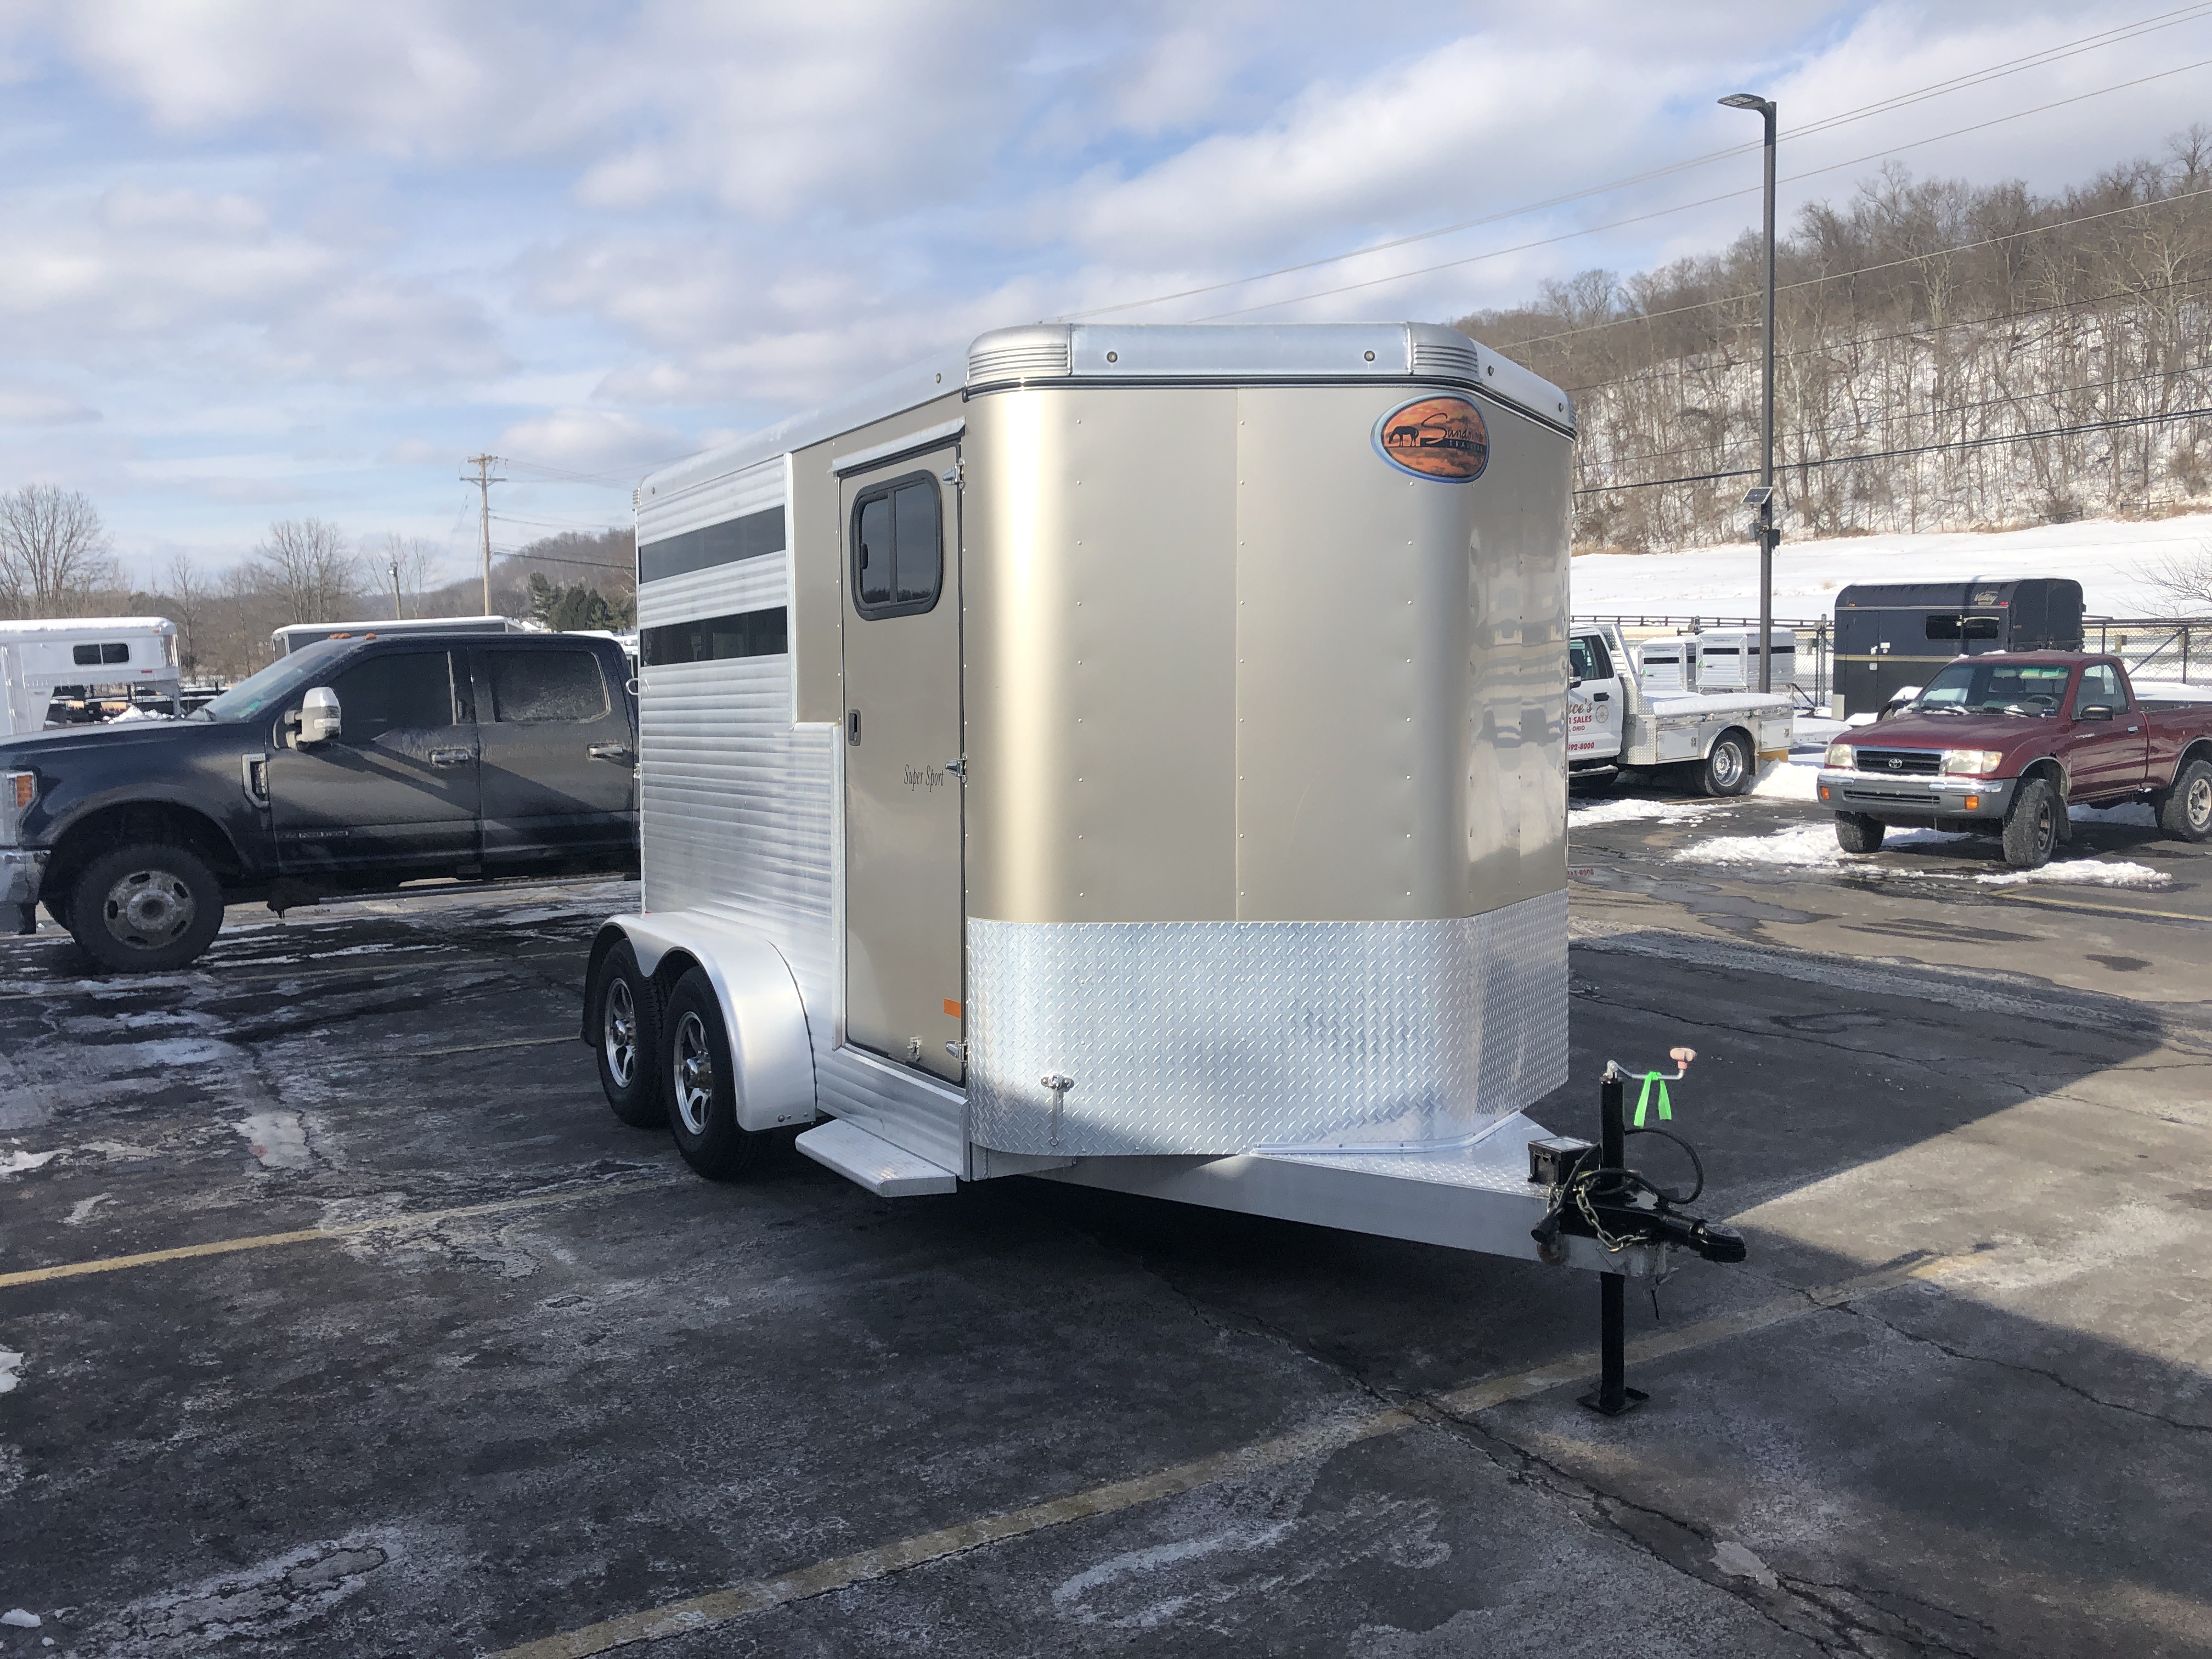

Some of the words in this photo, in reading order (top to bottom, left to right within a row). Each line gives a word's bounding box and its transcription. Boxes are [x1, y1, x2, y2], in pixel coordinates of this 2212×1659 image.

[1573, 715, 1592, 724] SALES
[904, 764, 924, 791] Super
[926, 765, 944, 793] Sport
